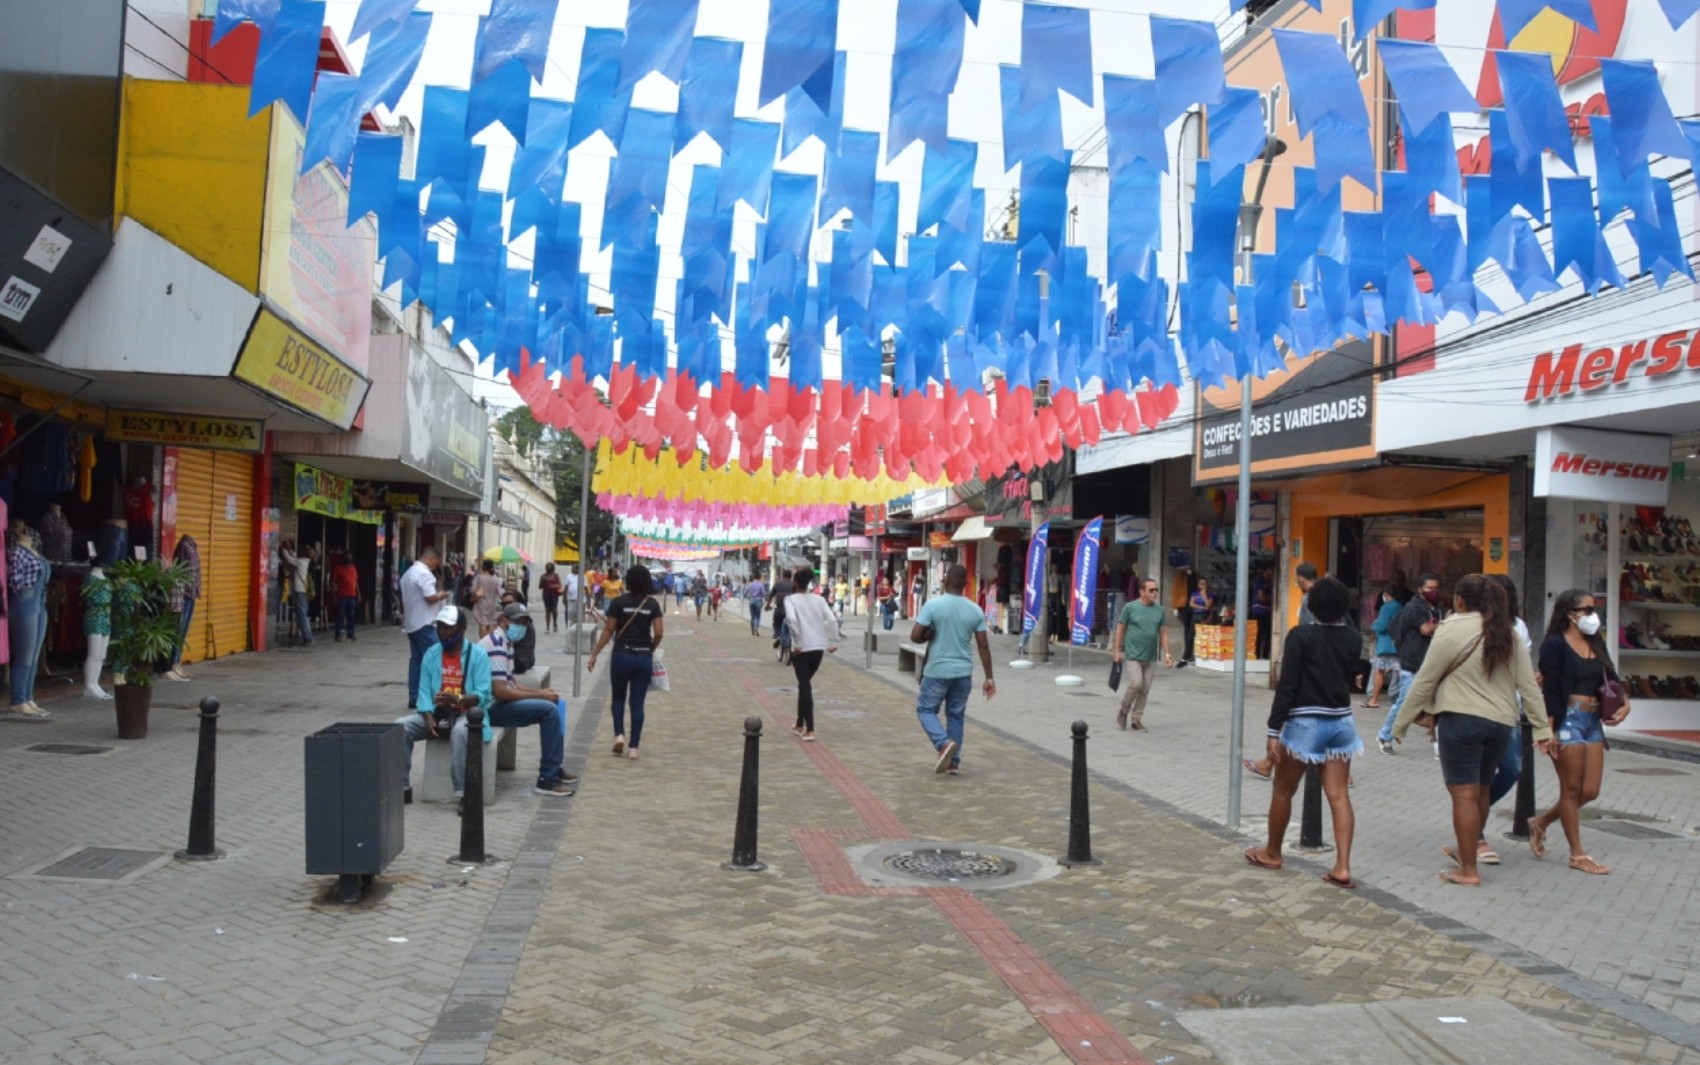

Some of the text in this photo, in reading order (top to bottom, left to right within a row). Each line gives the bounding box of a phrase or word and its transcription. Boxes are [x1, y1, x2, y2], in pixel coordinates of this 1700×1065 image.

[275, 334, 353, 404] ESTYLOSA
[122, 416, 256, 440] ESTYLOSA
[1273, 411, 1281, 433] E
[1284, 395, 1367, 431] VARIEDADES
[163, 434, 210, 443] CENTER
[1551, 452, 1669, 482] Mersan
